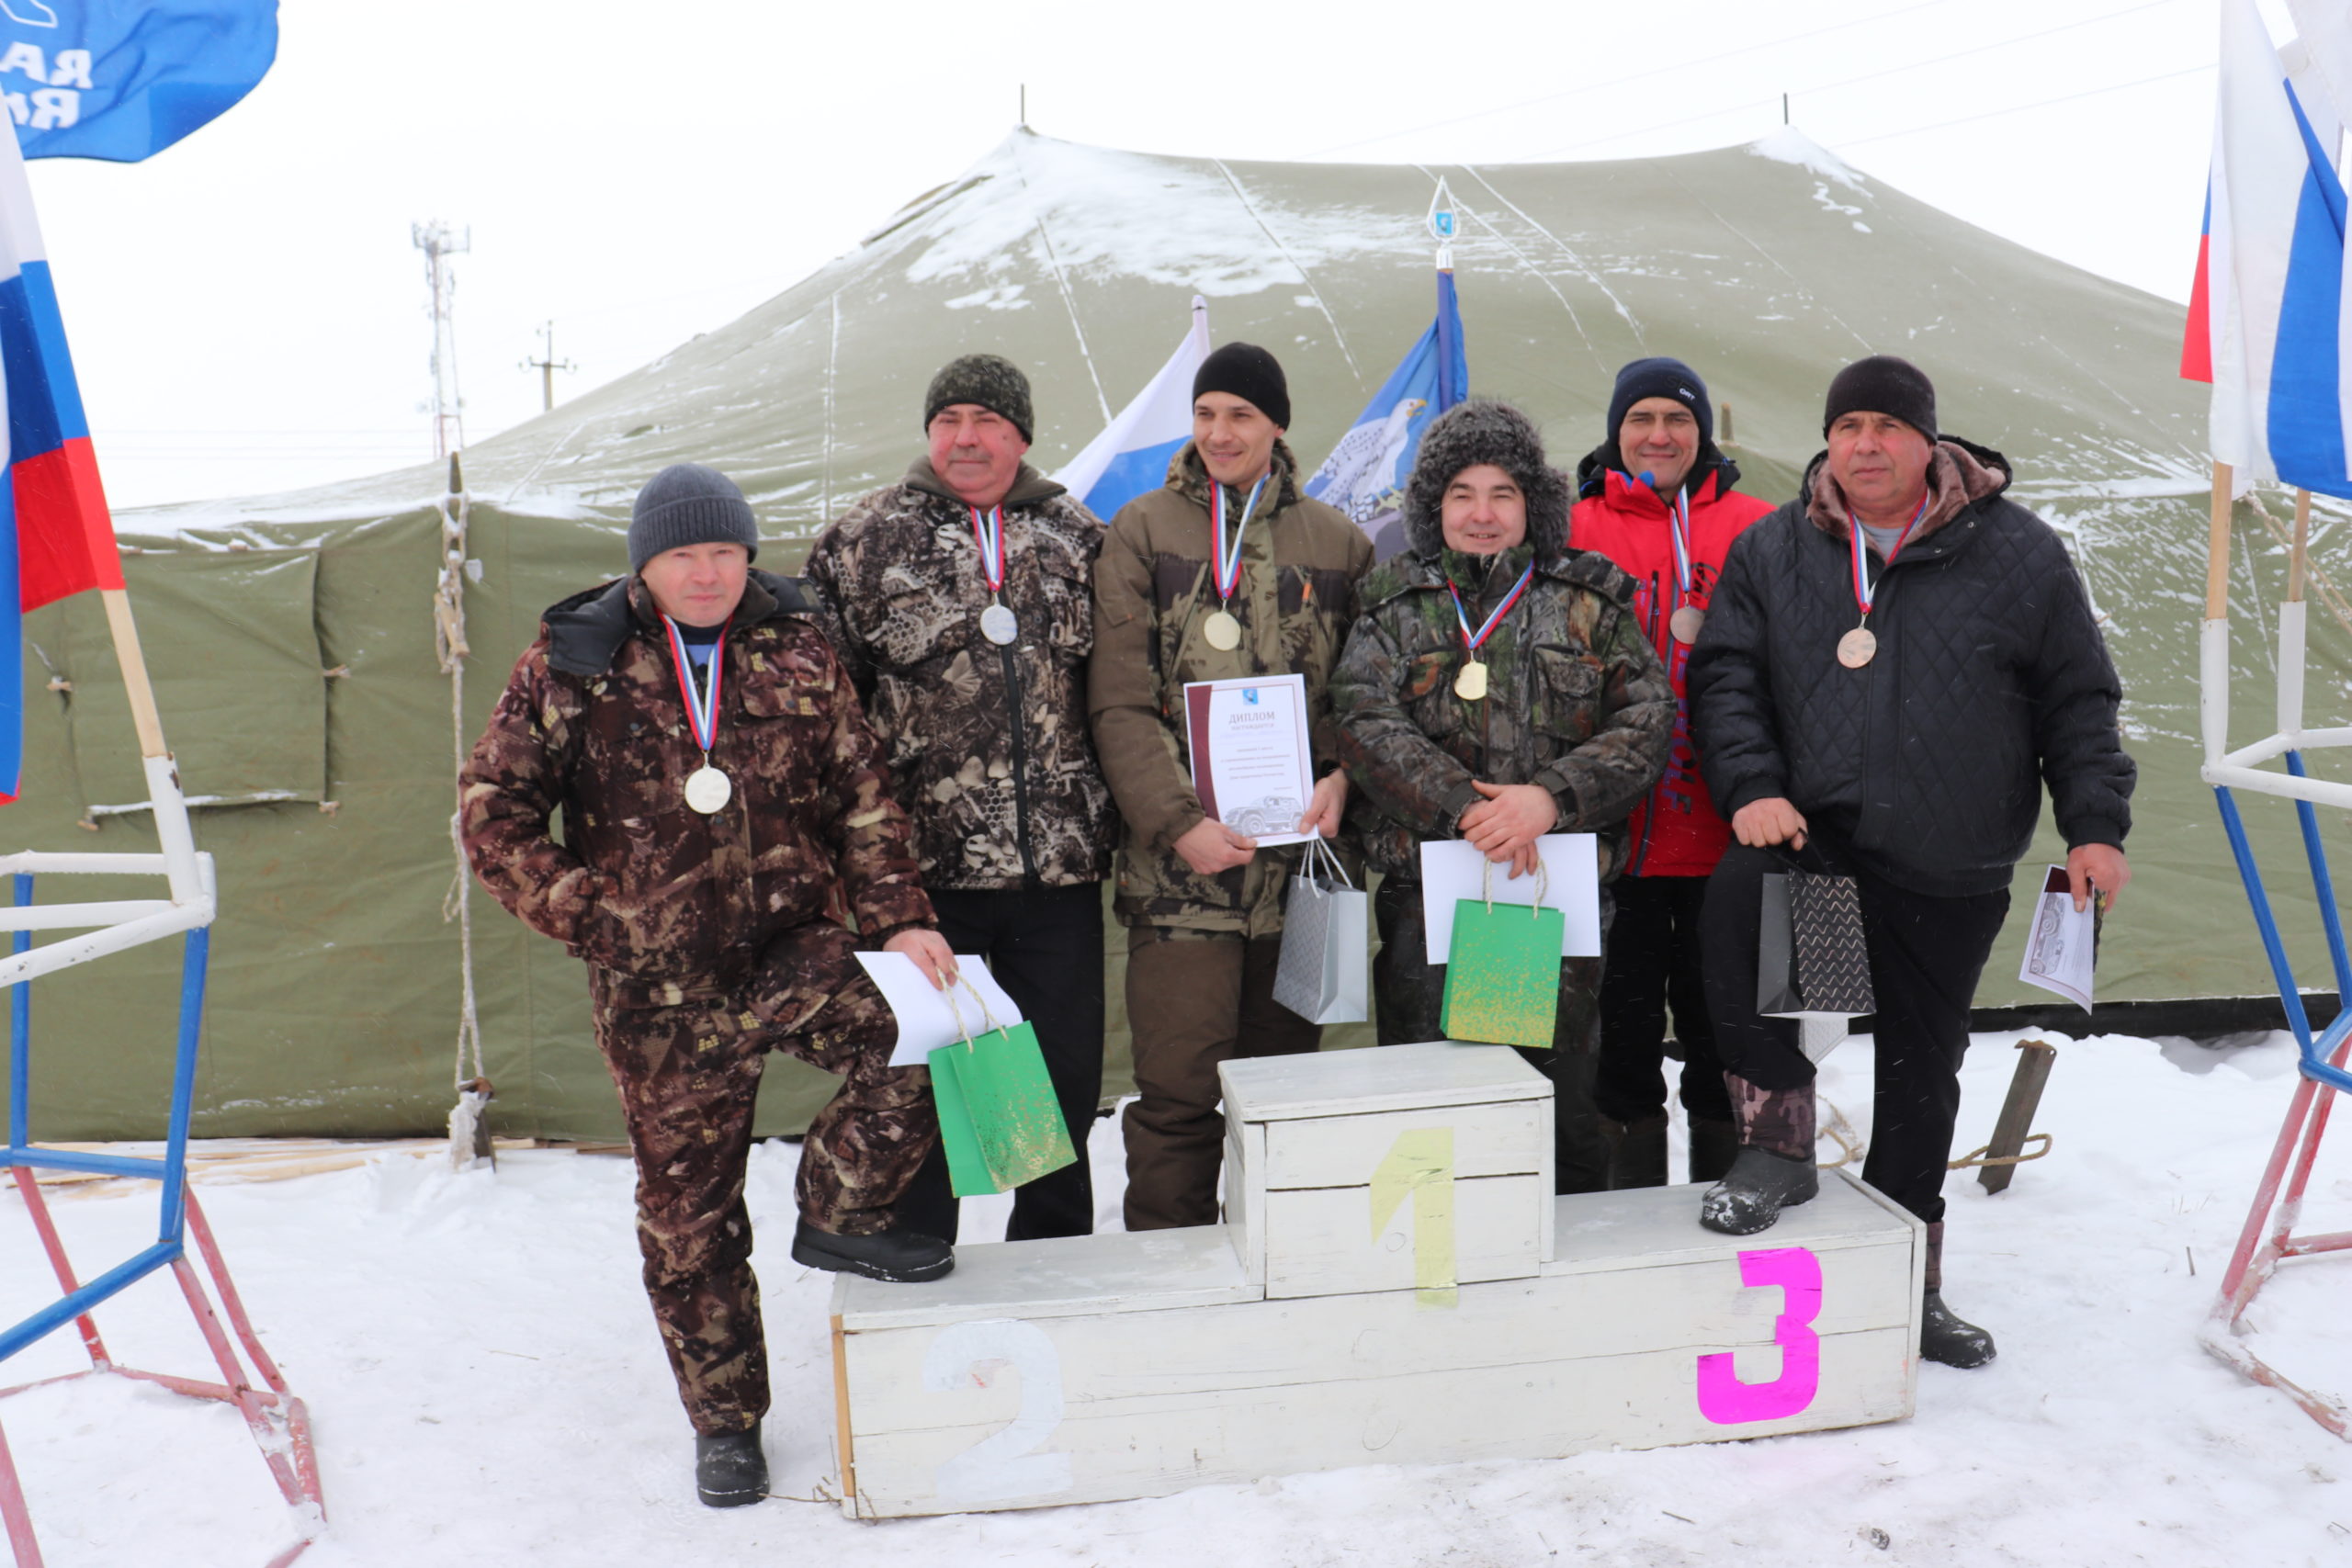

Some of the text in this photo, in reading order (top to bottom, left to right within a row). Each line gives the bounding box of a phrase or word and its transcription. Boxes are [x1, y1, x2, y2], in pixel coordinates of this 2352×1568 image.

[1228, 711, 1275, 725] ДИПЛОМ
[1370, 1126, 1459, 1310] 1
[922, 1317, 1074, 1503] 2
[1697, 1247, 1822, 1425] 3
